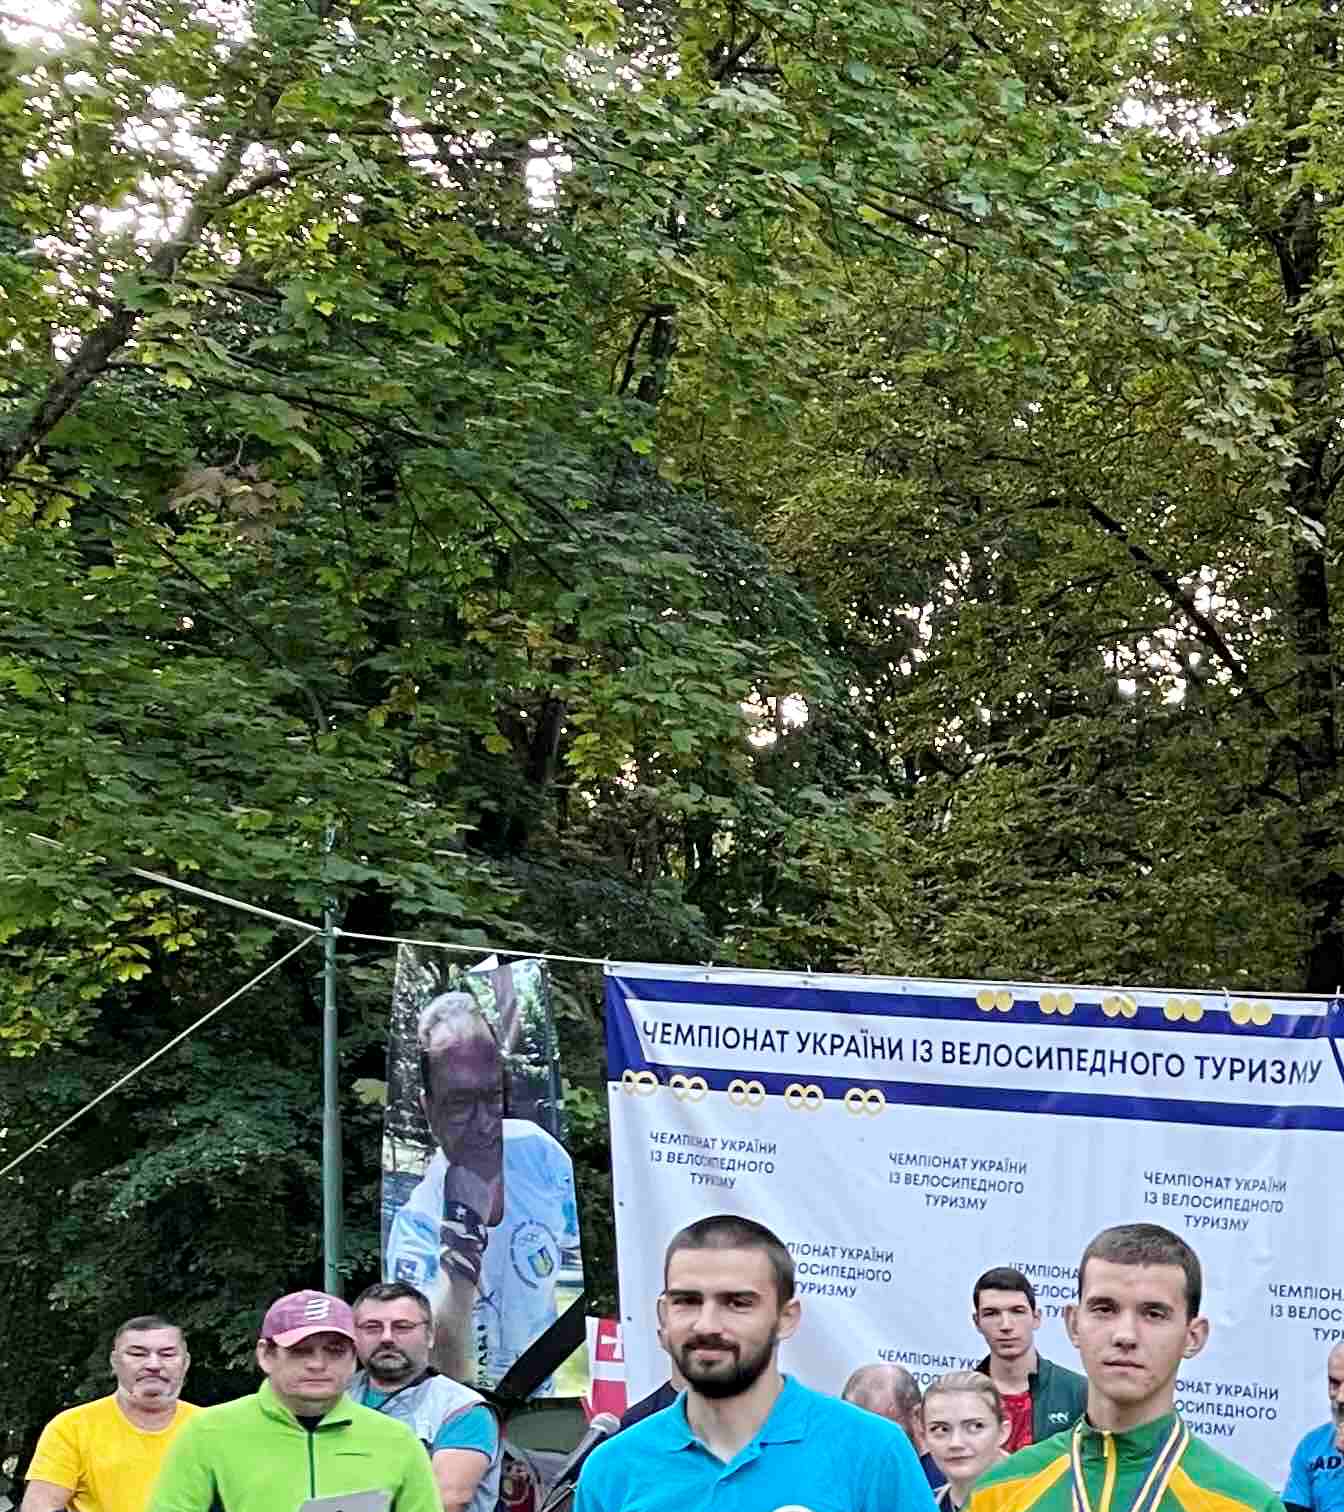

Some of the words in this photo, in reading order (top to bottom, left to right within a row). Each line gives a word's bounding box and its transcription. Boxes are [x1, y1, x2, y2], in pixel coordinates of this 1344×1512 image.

[643, 1021, 789, 1052] ЧЕМПІОНАТ
[797, 1030, 903, 1061] УКРАЇНИ
[912, 1041, 932, 1063] ІЗ
[942, 1042, 1184, 1078] ВЕЛОСИПЕДНОГО
[1195, 1055, 1322, 1085] ТУРИЗМУ
[720, 1138, 777, 1155] УКРАЇНИ
[650, 1151, 662, 1163] ІЗ
[889, 1152, 968, 1171] ЧЕМПІОНАТ
[970, 1157, 1027, 1175] УКРАЇНИ
[889, 1173, 901, 1185] ІЗ
[904, 1173, 1024, 1195] ВЕЛОСИПЕДНОГО
[1144, 1171, 1231, 1191] ЧЕМПІОНАТ
[1234, 1176, 1287, 1193] УКРАЇНИ
[925, 1194, 988, 1210] ТУРИЗМУ
[1143, 1191, 1158, 1205] ІЗ
[1162, 1192, 1283, 1214] ВЕЛОСИПЕДНОГО
[1184, 1214, 1249, 1232] ТУРИЗМУ
[787, 1242, 836, 1259] ПІОНАТ
[839, 1247, 894, 1263] УКРАЇНИ
[798, 1262, 892, 1282] ОСИПЕДНОГО
[1009, 1262, 1079, 1280] ЧЕМПІОНА
[1270, 1306, 1283, 1318] ІЗ
[877, 1349, 956, 1369] ЧЕМПІОНАТ
[1215, 1383, 1279, 1401] УКРАЇНИ
[1175, 1400, 1277, 1420] ОСИПЕДНОГО
[1186, 1420, 1236, 1437] РИЗМУ
